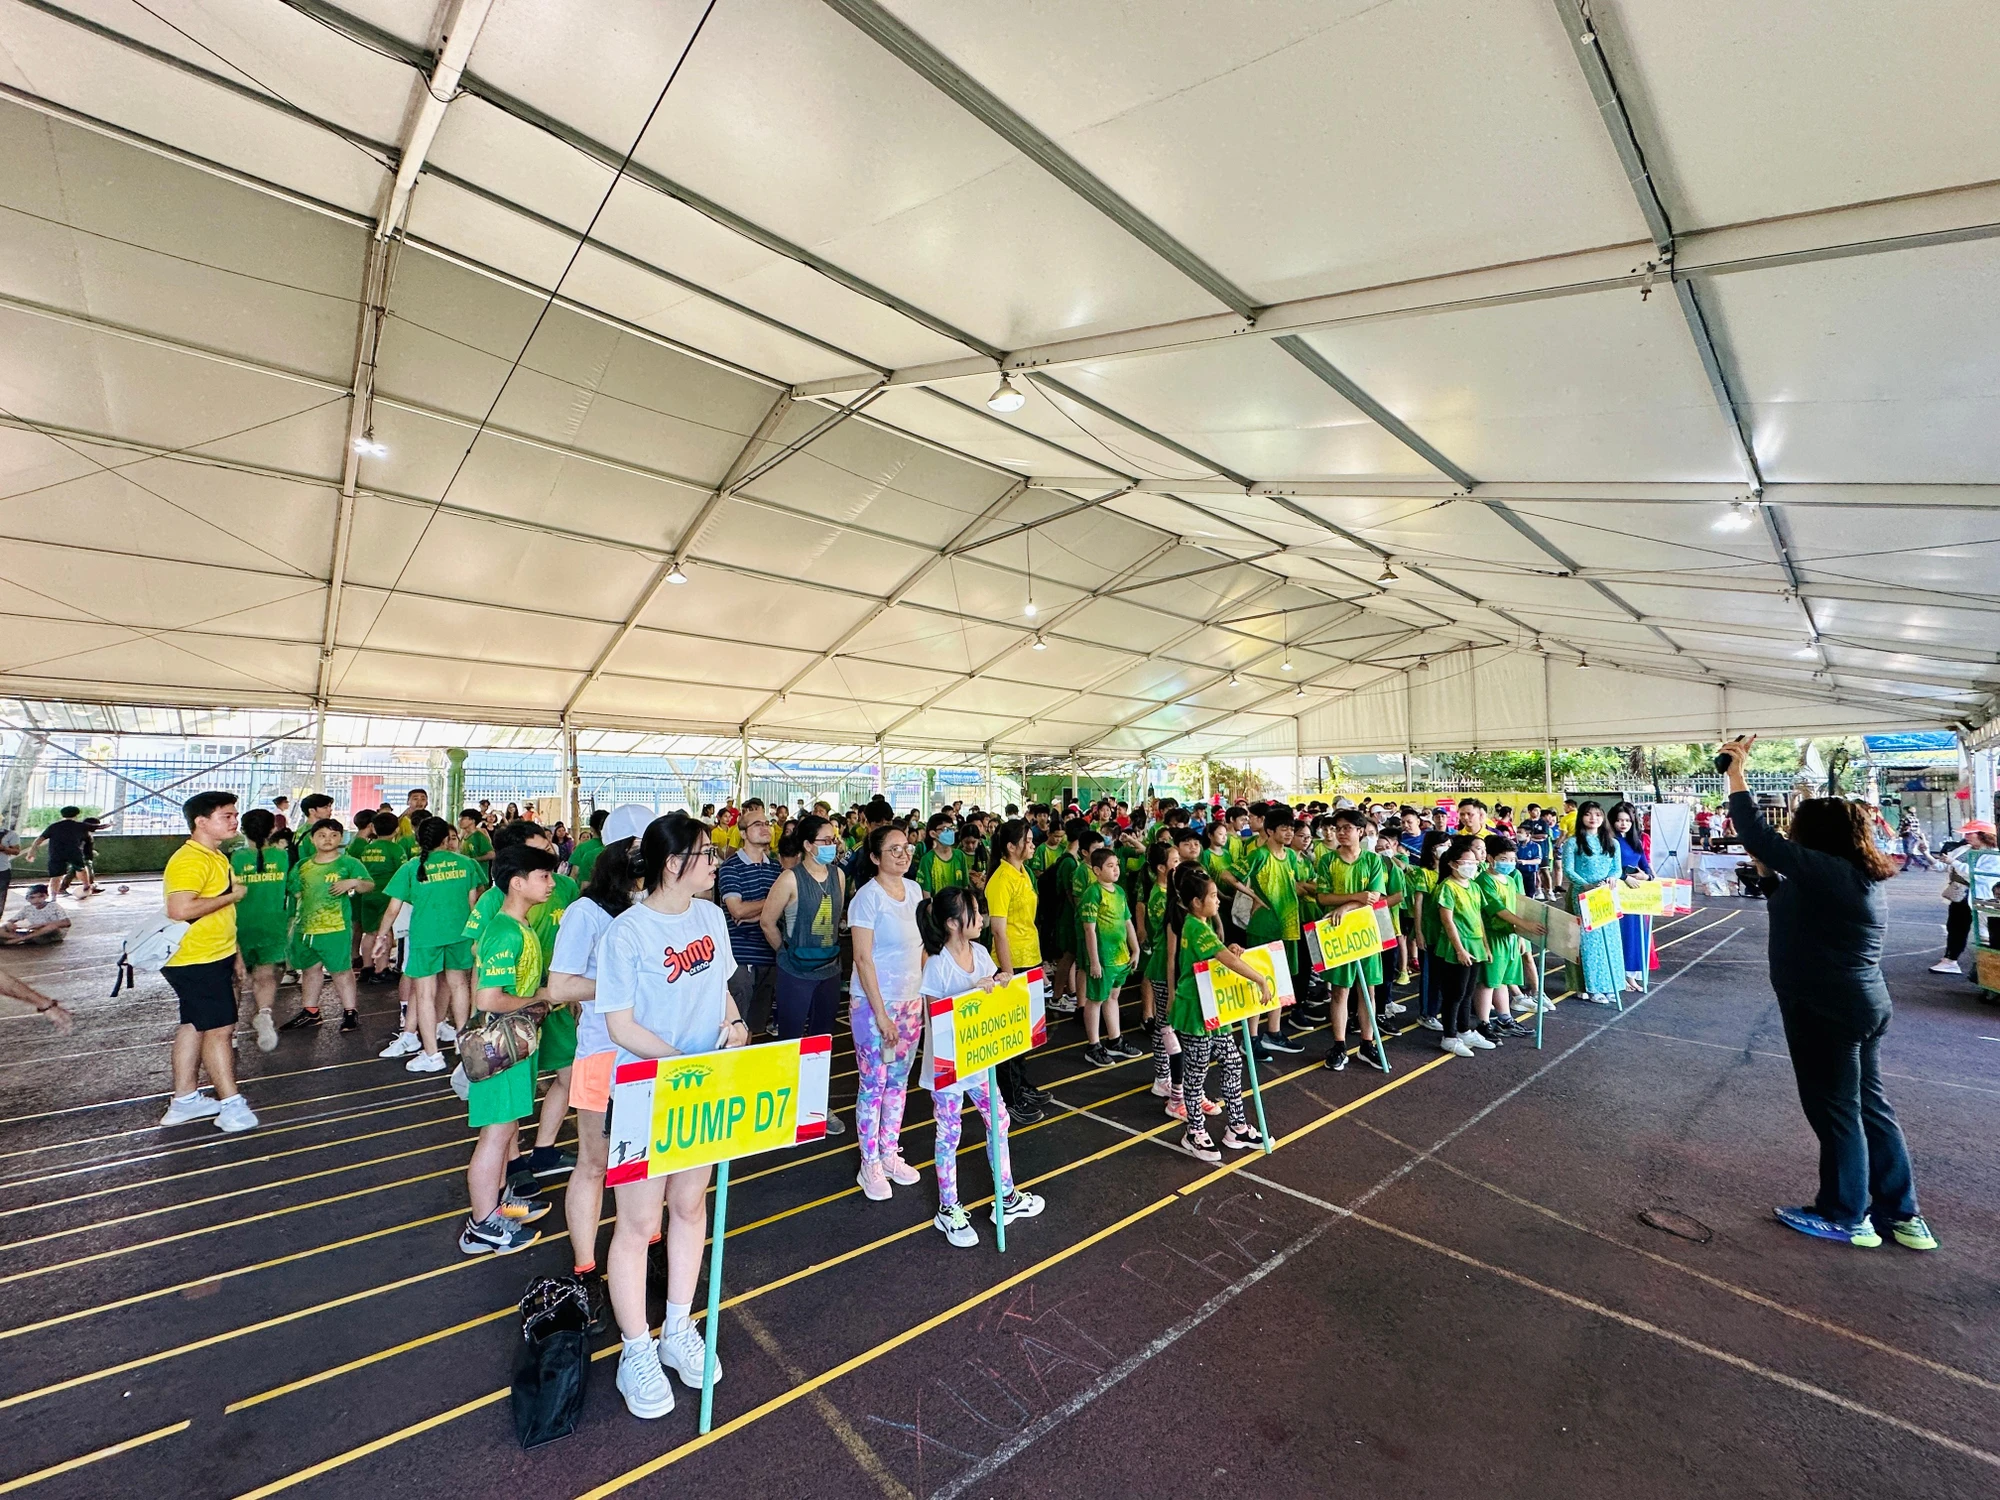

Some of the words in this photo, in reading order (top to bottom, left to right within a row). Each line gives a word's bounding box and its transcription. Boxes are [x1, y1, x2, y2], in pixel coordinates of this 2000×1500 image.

[811, 894, 834, 948] 4
[1324, 926, 1379, 960] CELADON
[1215, 977, 1245, 1014] PHÚ
[959, 1023, 979, 1046] VẬN
[981, 1013, 1007, 1037] ĐỘNG
[1008, 1004, 1027, 1025] VIÊN
[966, 1040, 999, 1067] PHONG
[1000, 1029, 1024, 1052] TRÀO
[655, 1096, 746, 1154] JUMP
[754, 1087, 792, 1133] D7
